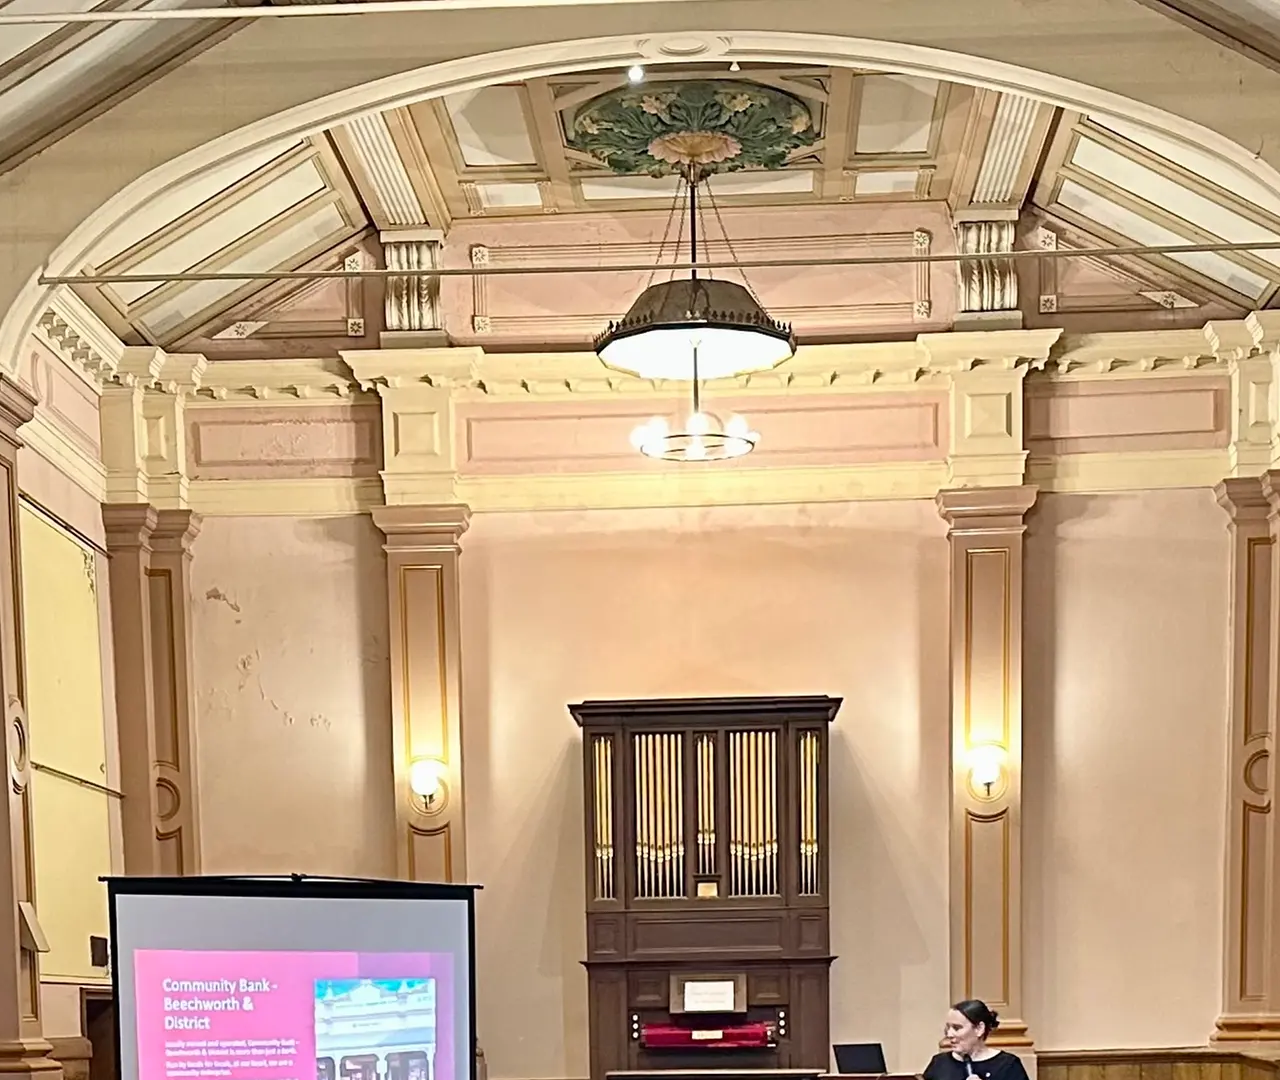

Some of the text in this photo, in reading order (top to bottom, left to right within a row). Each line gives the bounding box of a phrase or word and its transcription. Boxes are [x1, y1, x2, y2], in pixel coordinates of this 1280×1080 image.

[162, 978, 237, 995] Community
[239, 978, 271, 992] Bank
[163, 996, 254, 1011] Beechworth &
[164, 1016, 211, 1030] District
